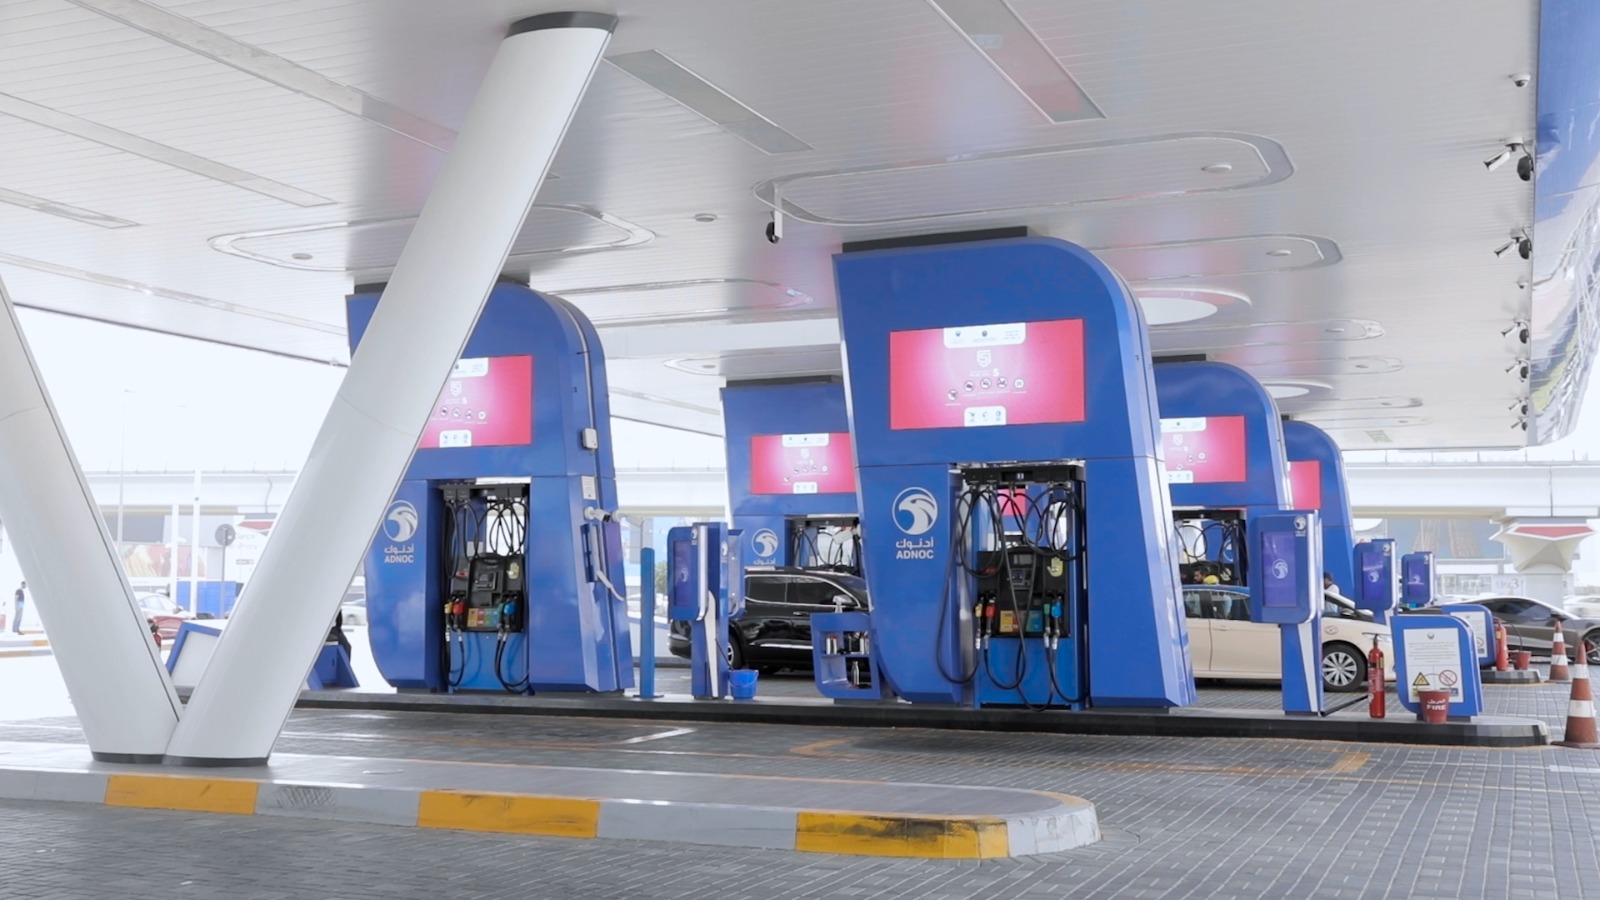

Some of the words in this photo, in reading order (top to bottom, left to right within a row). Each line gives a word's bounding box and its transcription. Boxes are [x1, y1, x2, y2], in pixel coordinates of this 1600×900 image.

[895, 536, 934, 549] أدنوك
[384, 543, 414, 554] أدنوك
[384, 555, 414, 563] ADNOC
[896, 549, 934, 559] ADNOC
